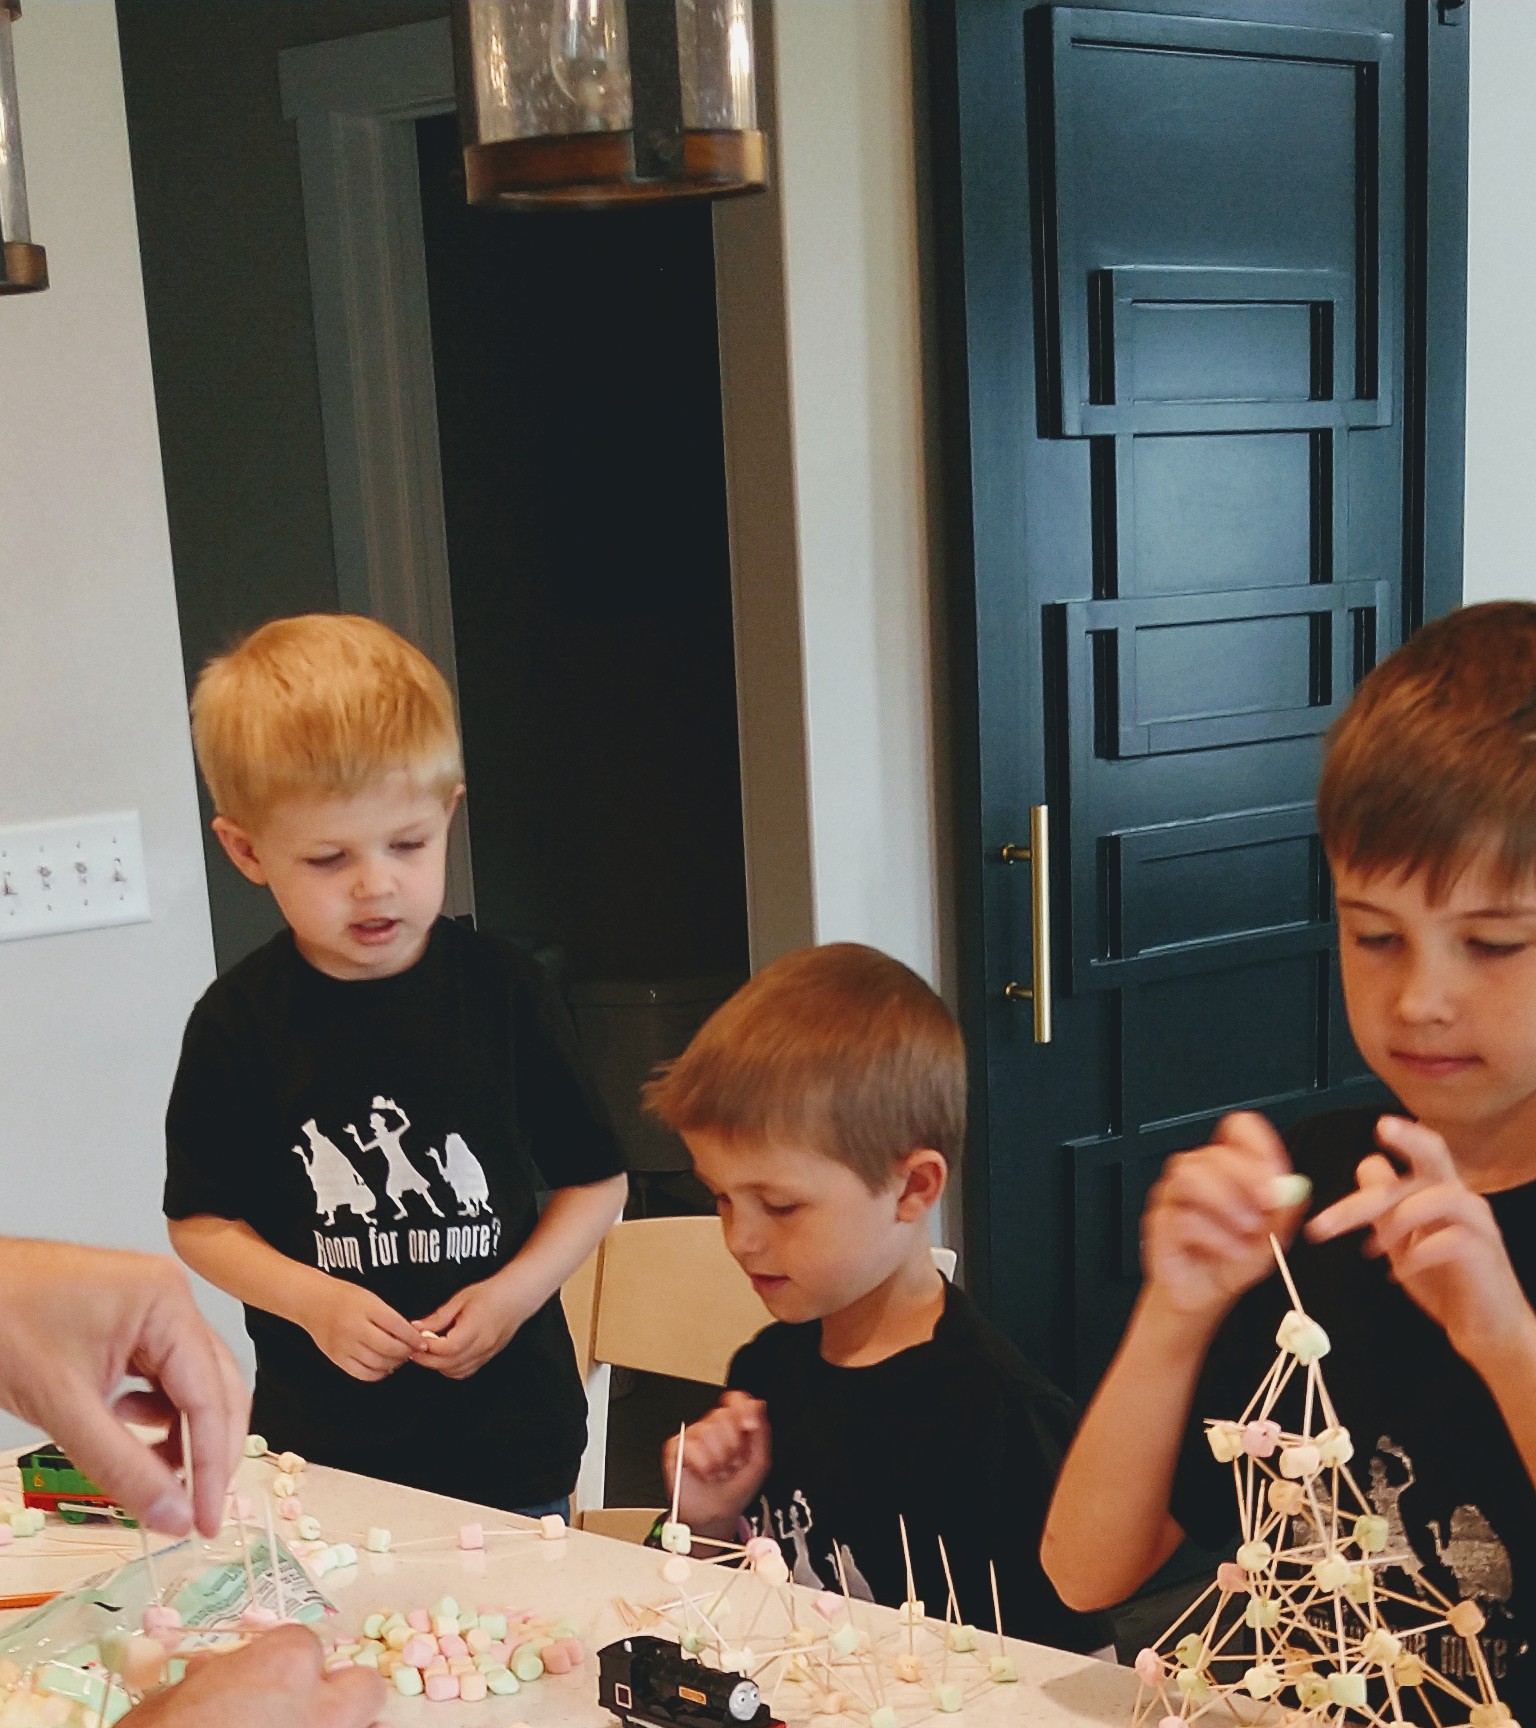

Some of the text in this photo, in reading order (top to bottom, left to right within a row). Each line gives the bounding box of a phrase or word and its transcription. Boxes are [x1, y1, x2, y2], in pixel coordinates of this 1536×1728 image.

[313, 1216, 501, 1275] Room for one more?
